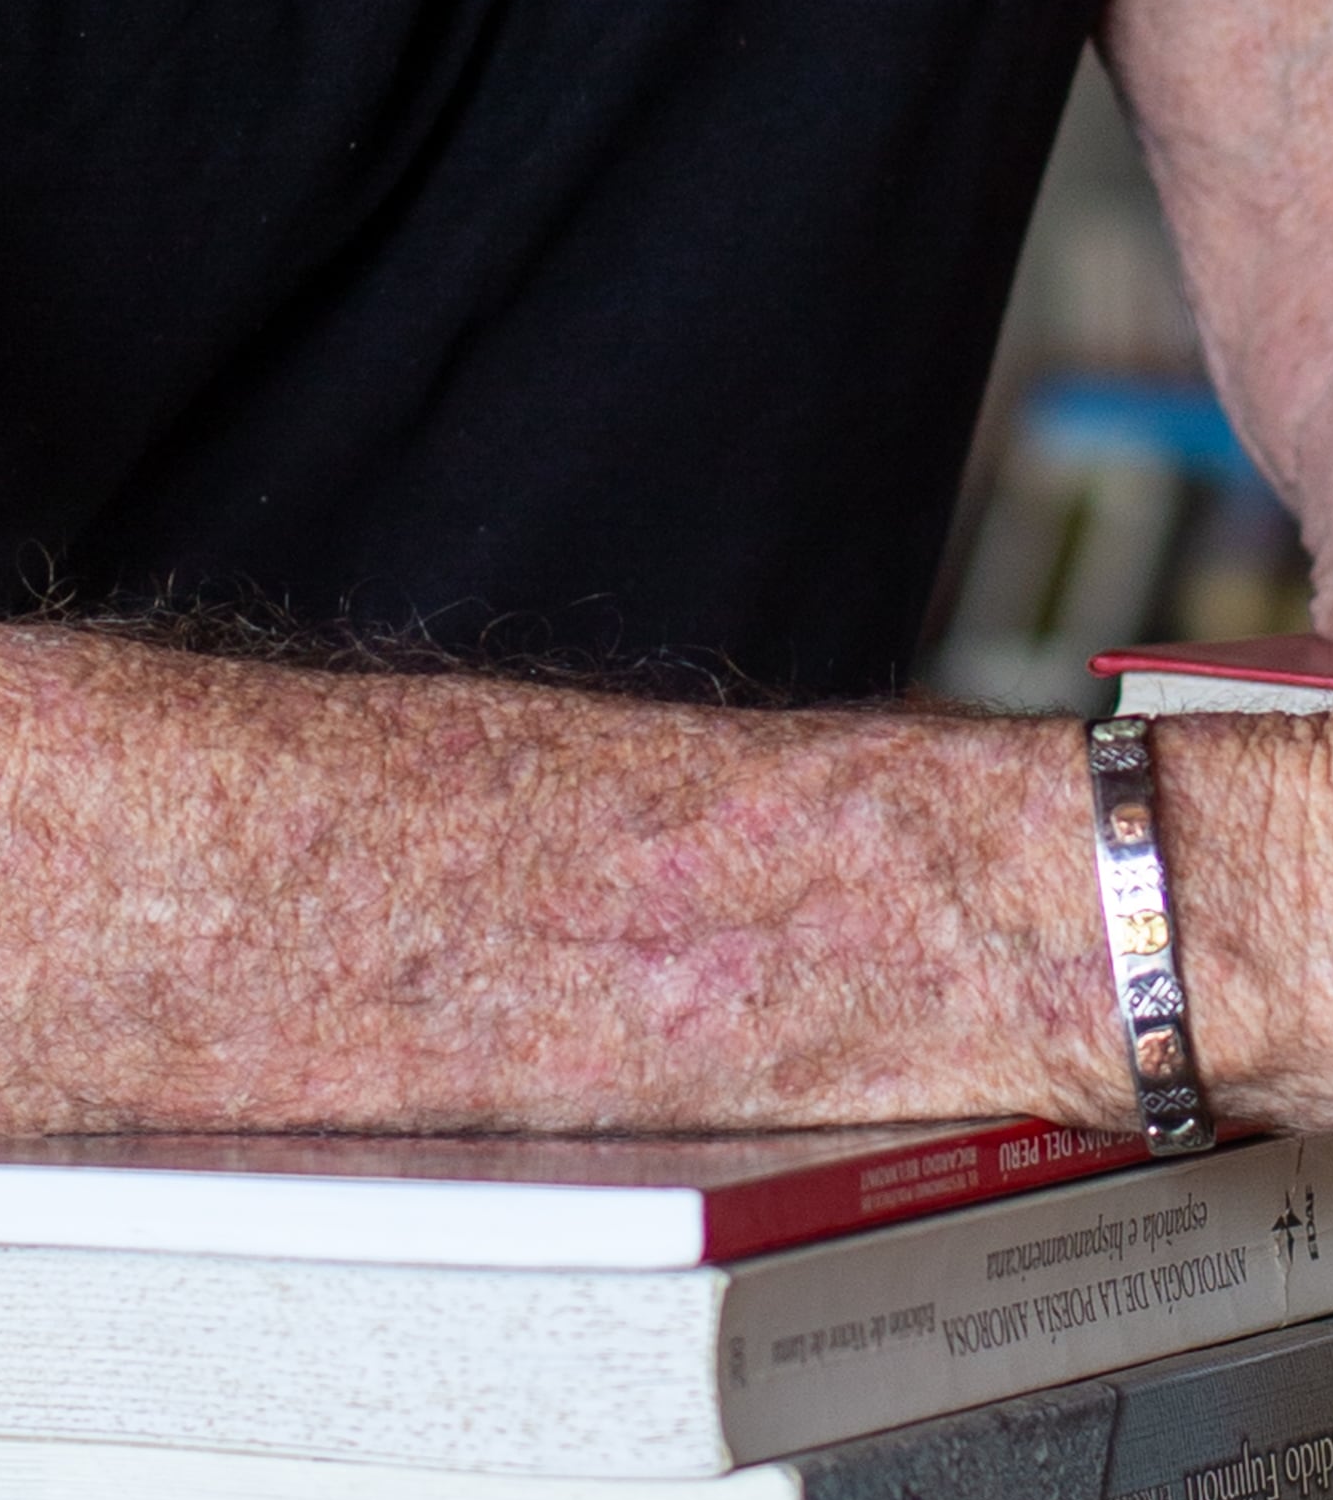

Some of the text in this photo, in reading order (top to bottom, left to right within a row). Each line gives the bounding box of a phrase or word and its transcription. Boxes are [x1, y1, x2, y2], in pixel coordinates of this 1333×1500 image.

[922, 1146, 977, 1176] RICARDO
[999, 1136, 1039, 1181] PERÚ
[1044, 1129, 1072, 1159] DEL
[987, 1194, 1207, 1283] española e hispanoamericana
[1303, 1183, 1321, 1262] EDAF
[943, 1246, 1247, 1357] ANTOLOGÍA DE LA POESÍA AMOROSA
[870, 1315, 886, 1348] de
[889, 1302, 936, 1339] Edición
[810, 1330, 827, 1363] de
